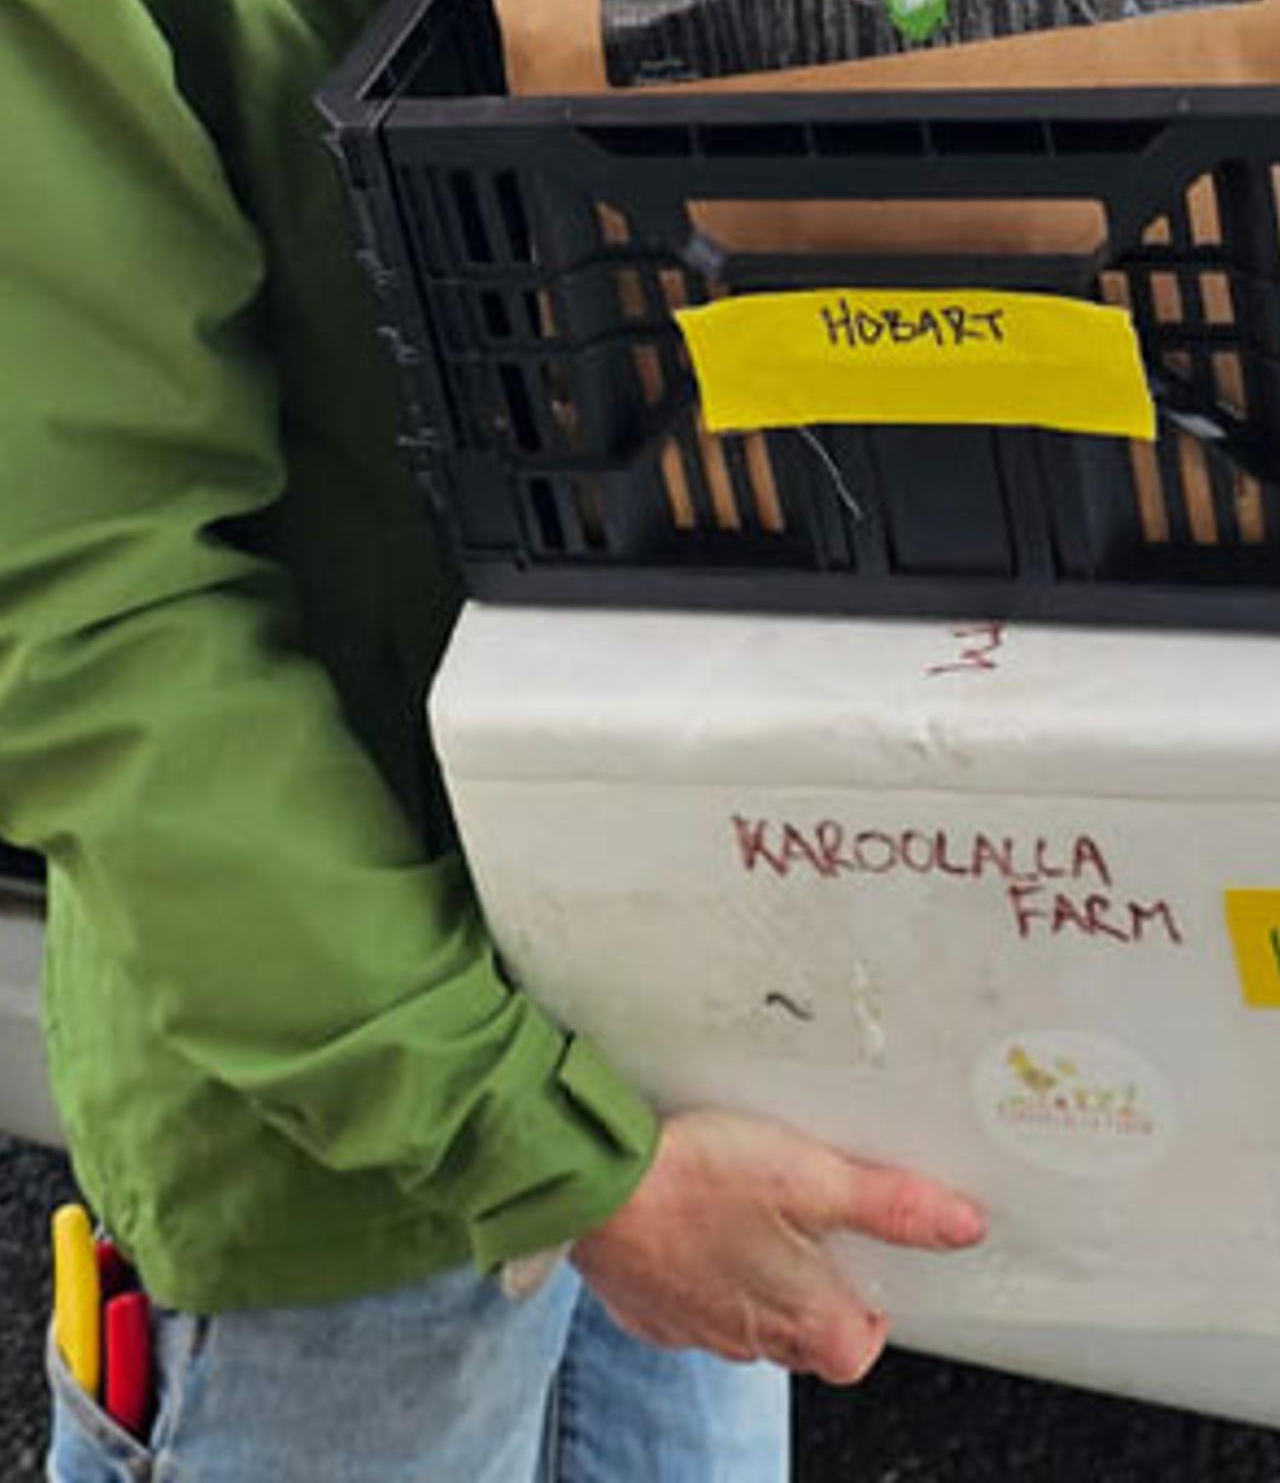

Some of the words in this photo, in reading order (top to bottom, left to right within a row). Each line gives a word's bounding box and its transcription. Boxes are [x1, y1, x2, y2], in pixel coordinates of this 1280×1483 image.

[821, 298, 1005, 347] HOBART
[732, 813, 1113, 887] KAROOLALLA
[1007, 883, 1182, 945] FARM
